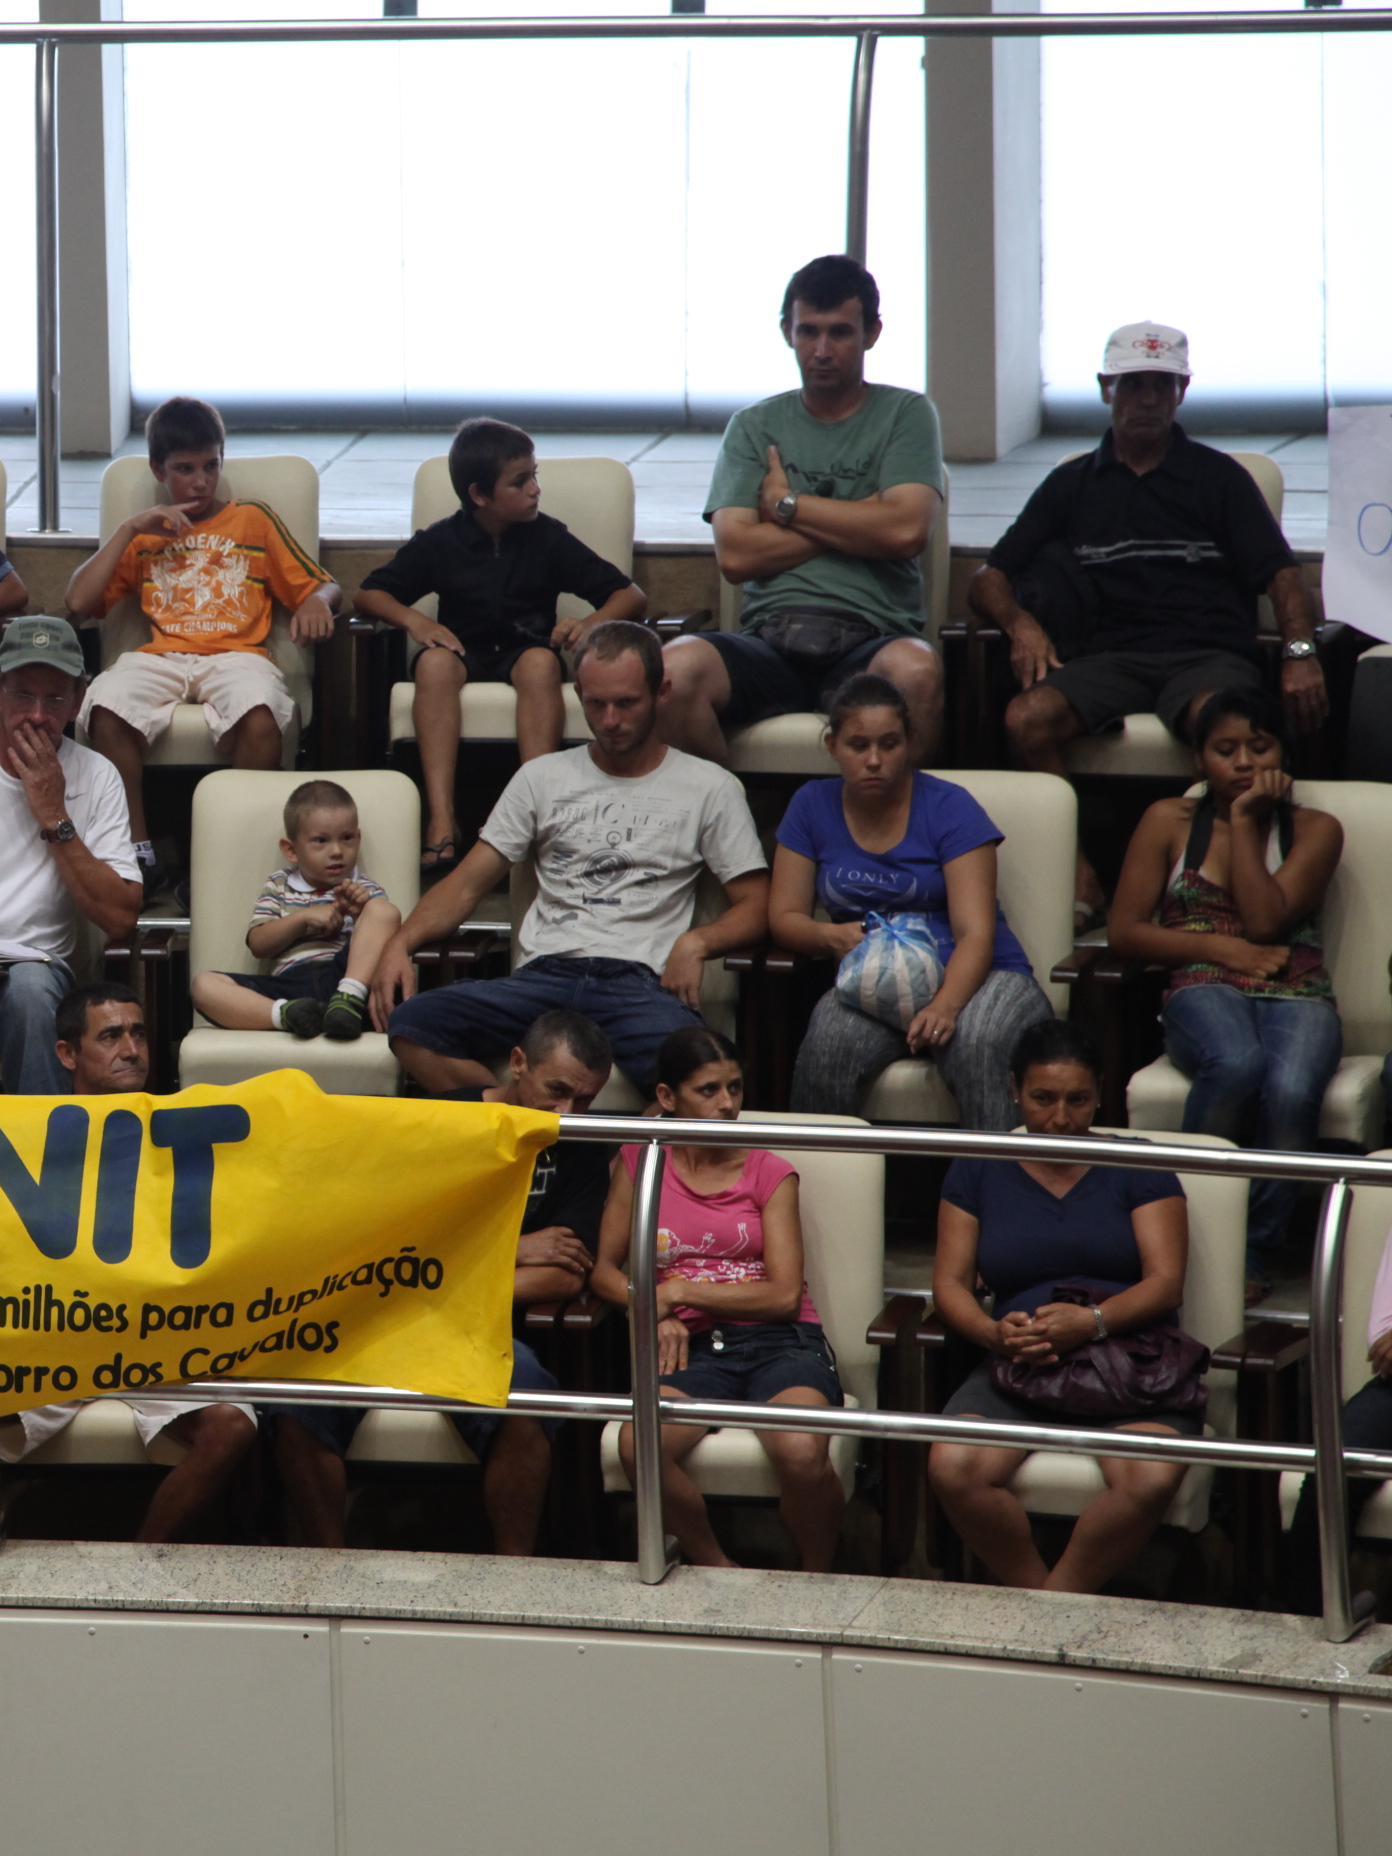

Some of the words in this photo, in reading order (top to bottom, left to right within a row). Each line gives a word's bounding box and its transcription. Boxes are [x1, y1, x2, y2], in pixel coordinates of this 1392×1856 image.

[164, 533, 236, 561] PHOENIX
[184, 620, 238, 633] CHAMPIONS
[848, 870, 899, 884] ONLY
[139, 1301, 235, 1340] para
[246, 1246, 444, 1323] duplicação
[92, 1352, 164, 1390] dos
[178, 1317, 340, 1379] Cavalos
